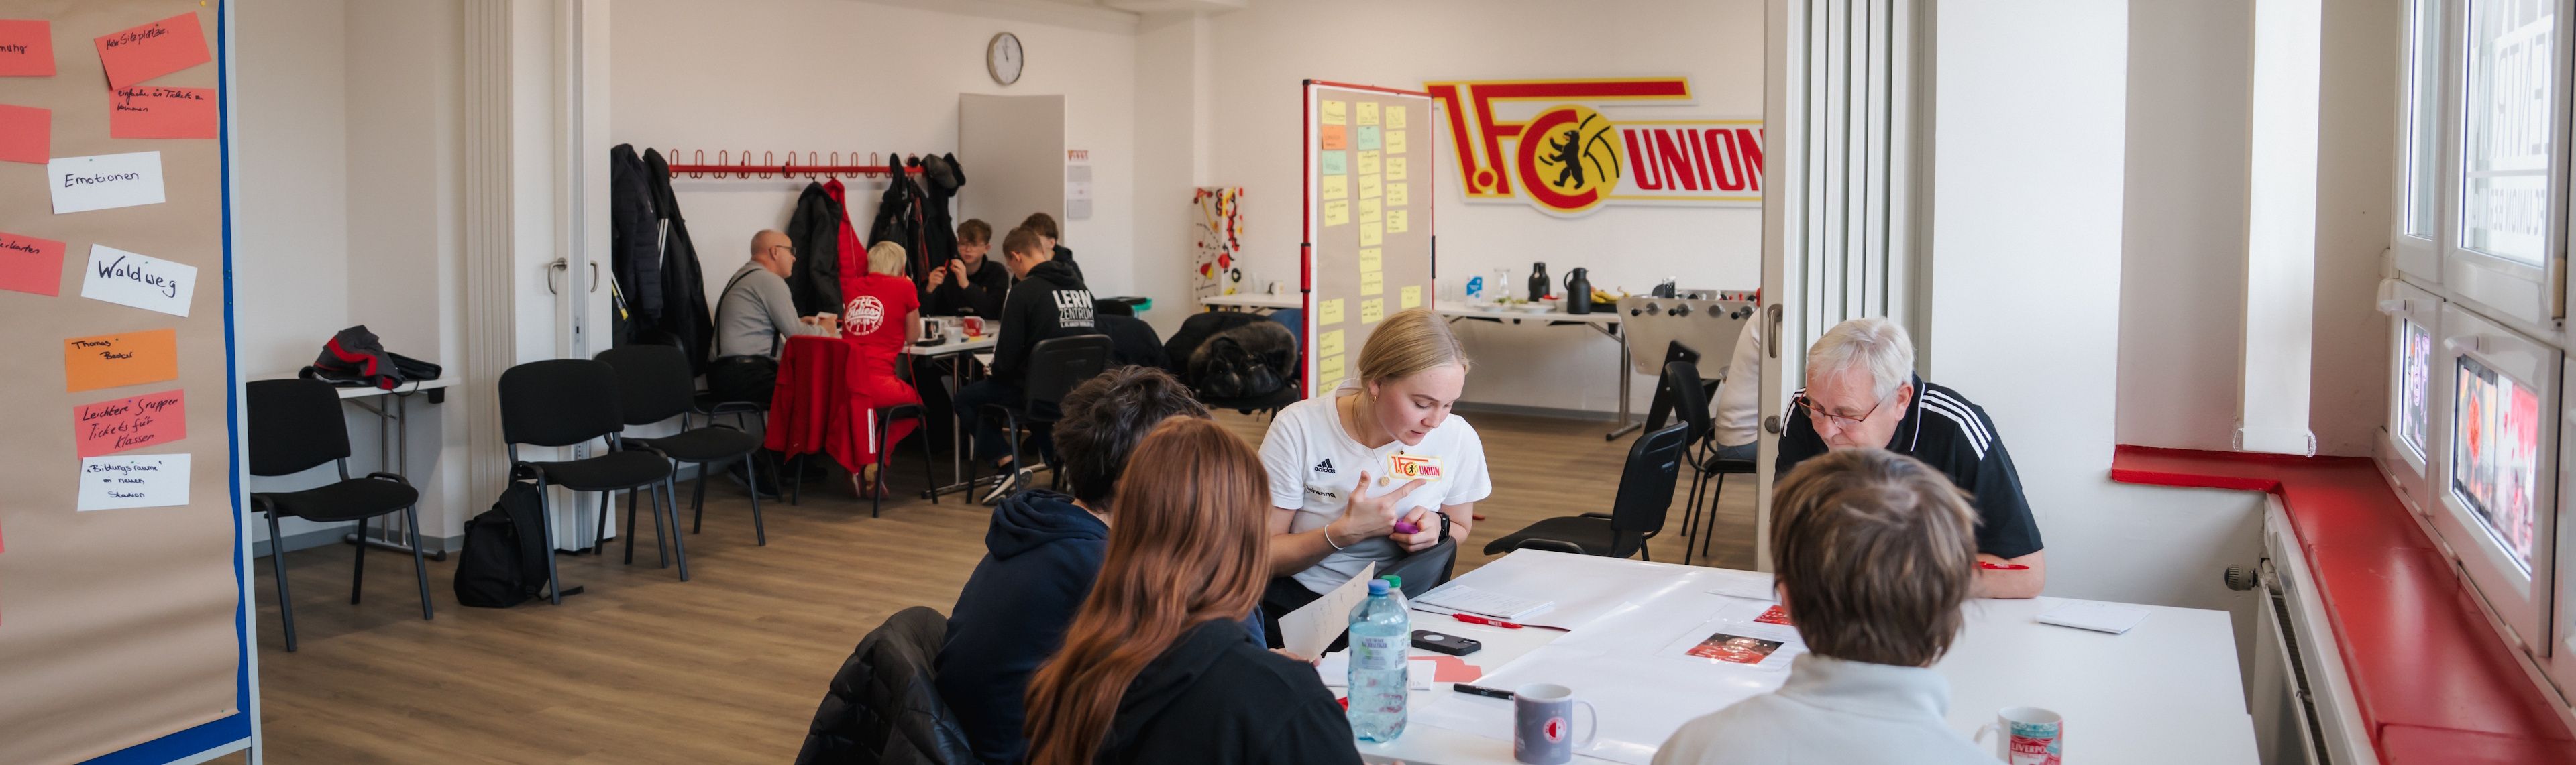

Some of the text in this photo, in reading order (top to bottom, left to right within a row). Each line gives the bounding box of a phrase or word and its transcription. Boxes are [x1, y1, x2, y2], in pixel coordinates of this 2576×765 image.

[1623, 128, 1764, 191] UNION
[64, 172, 140, 187] Emotionen
[1052, 290, 1093, 308] LERN
[1059, 308, 1094, 320] ZENTRUM
[71, 340, 111, 349] Thomas
[83, 405, 129, 421] Leichtere
[89, 416, 153, 440] Tickets für
[114, 434, 154, 449] Klassen
[1314, 466, 1336, 474] adidas
[1419, 465, 1440, 477] UNION
[1305, 484, 1337, 499] Johanna
[2012, 742, 2047, 753] LIVERPO
